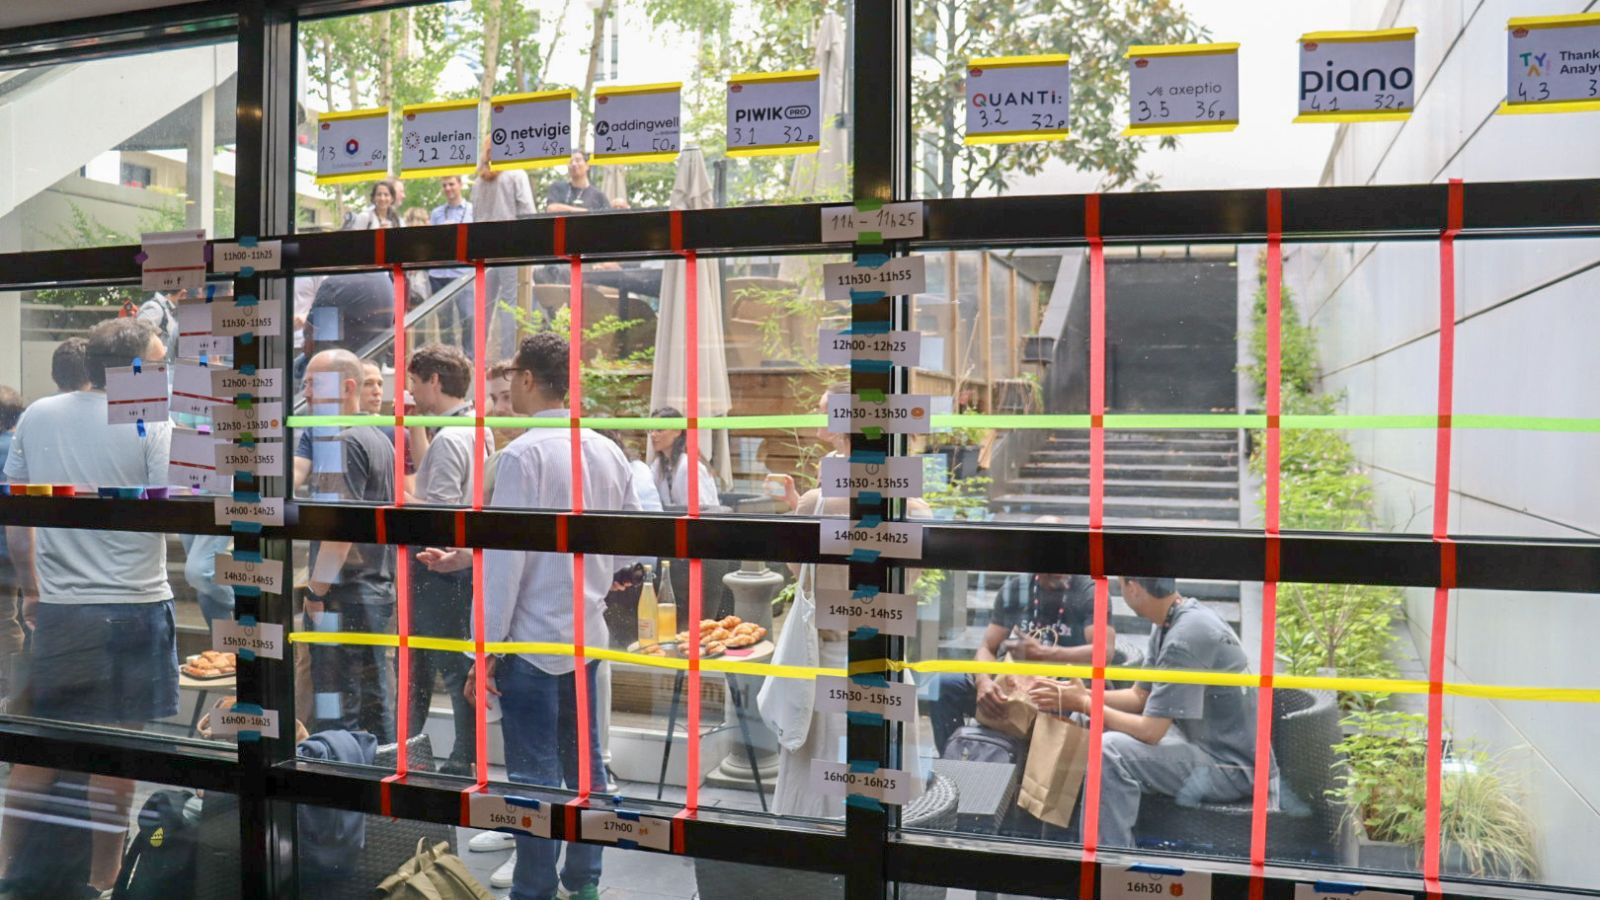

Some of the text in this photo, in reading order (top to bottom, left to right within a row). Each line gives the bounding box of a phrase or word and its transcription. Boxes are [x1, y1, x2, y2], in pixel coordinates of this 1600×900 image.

[1559, 49, 1600, 61] Thank
[1300, 60, 1413, 100] piano
[1169, 82, 1222, 97] axeptio
[1518, 82, 1550, 102] 4.3
[1138, 100, 1225, 121] 3.5 36p
[1310, 95, 1340, 112] 4.1
[735, 106, 807, 123] PIWIK PRO
[979, 109, 1065, 130] 3.2 32p
[511, 121, 570, 140] netvigie
[611, 117, 679, 132] addingwell
[606, 134, 629, 151] 2.4
[784, 125, 814, 144] 32p
[504, 141, 525, 156] 2.3
[832, 214, 854, 230] 11h
[876, 209, 917, 228] 11h25
[490, 814, 516, 825] 16h30
[604, 821, 633, 833] 17h00
[1127, 882, 1163, 894] 16h30
